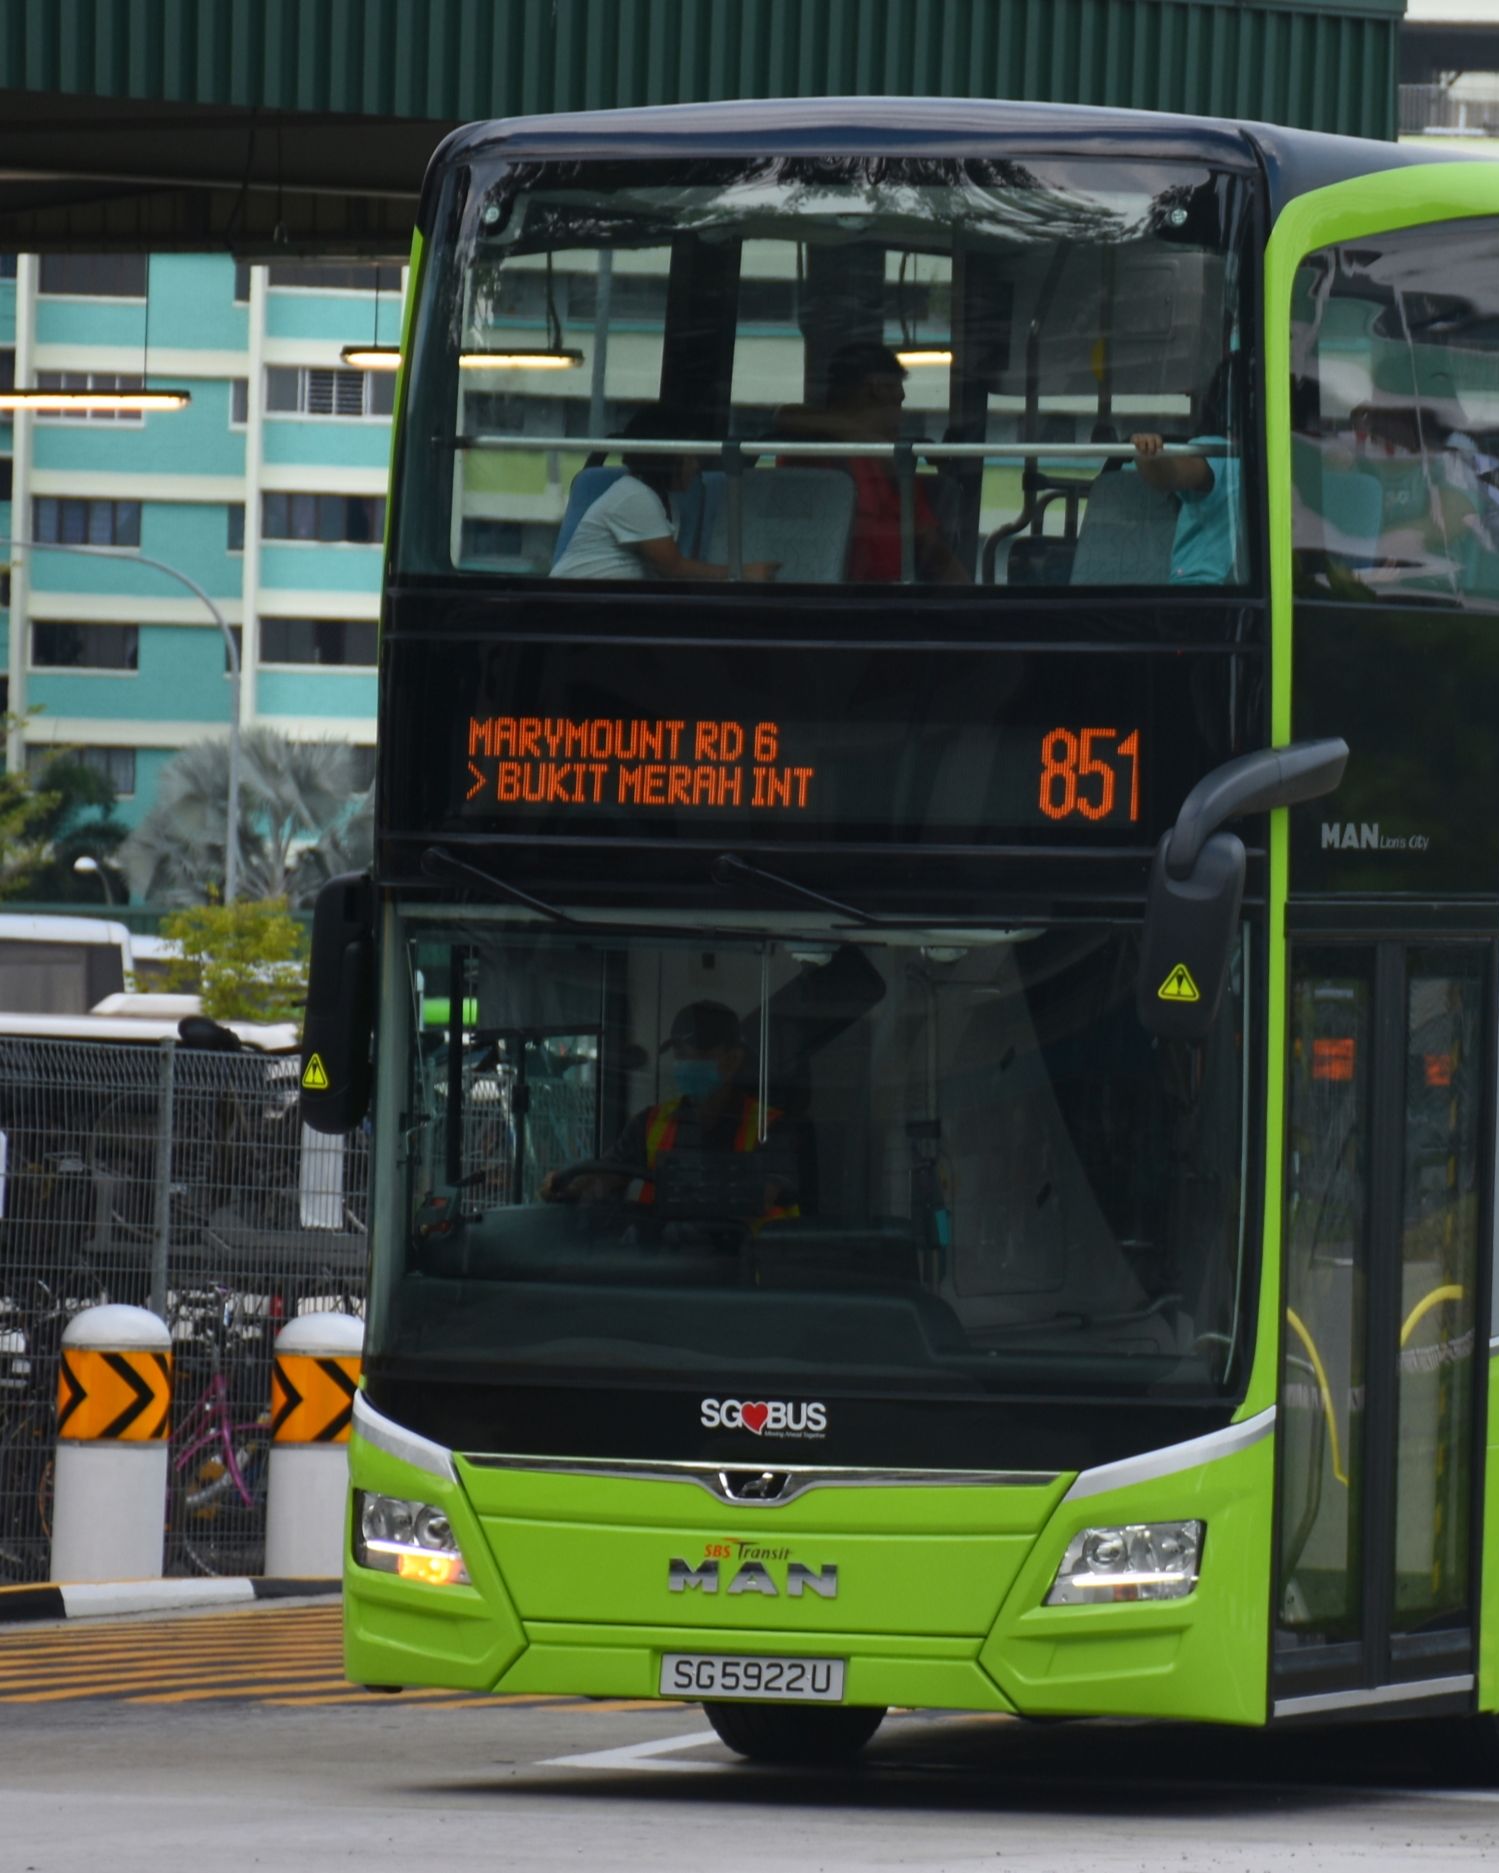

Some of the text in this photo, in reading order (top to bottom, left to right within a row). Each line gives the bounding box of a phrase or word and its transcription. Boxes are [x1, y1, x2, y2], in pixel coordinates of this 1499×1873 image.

[468, 717, 779, 763] MARYMOUNT RD 6
[497, 761, 815, 808] BUKIT MERAH INT
[1040, 727, 1139, 822] 851
[1321, 822, 1379, 849] MAN
[703, 1541, 792, 1561] SBS Transit
[668, 1558, 838, 1600] MAN
[673, 1660, 832, 1694] SG5922U
